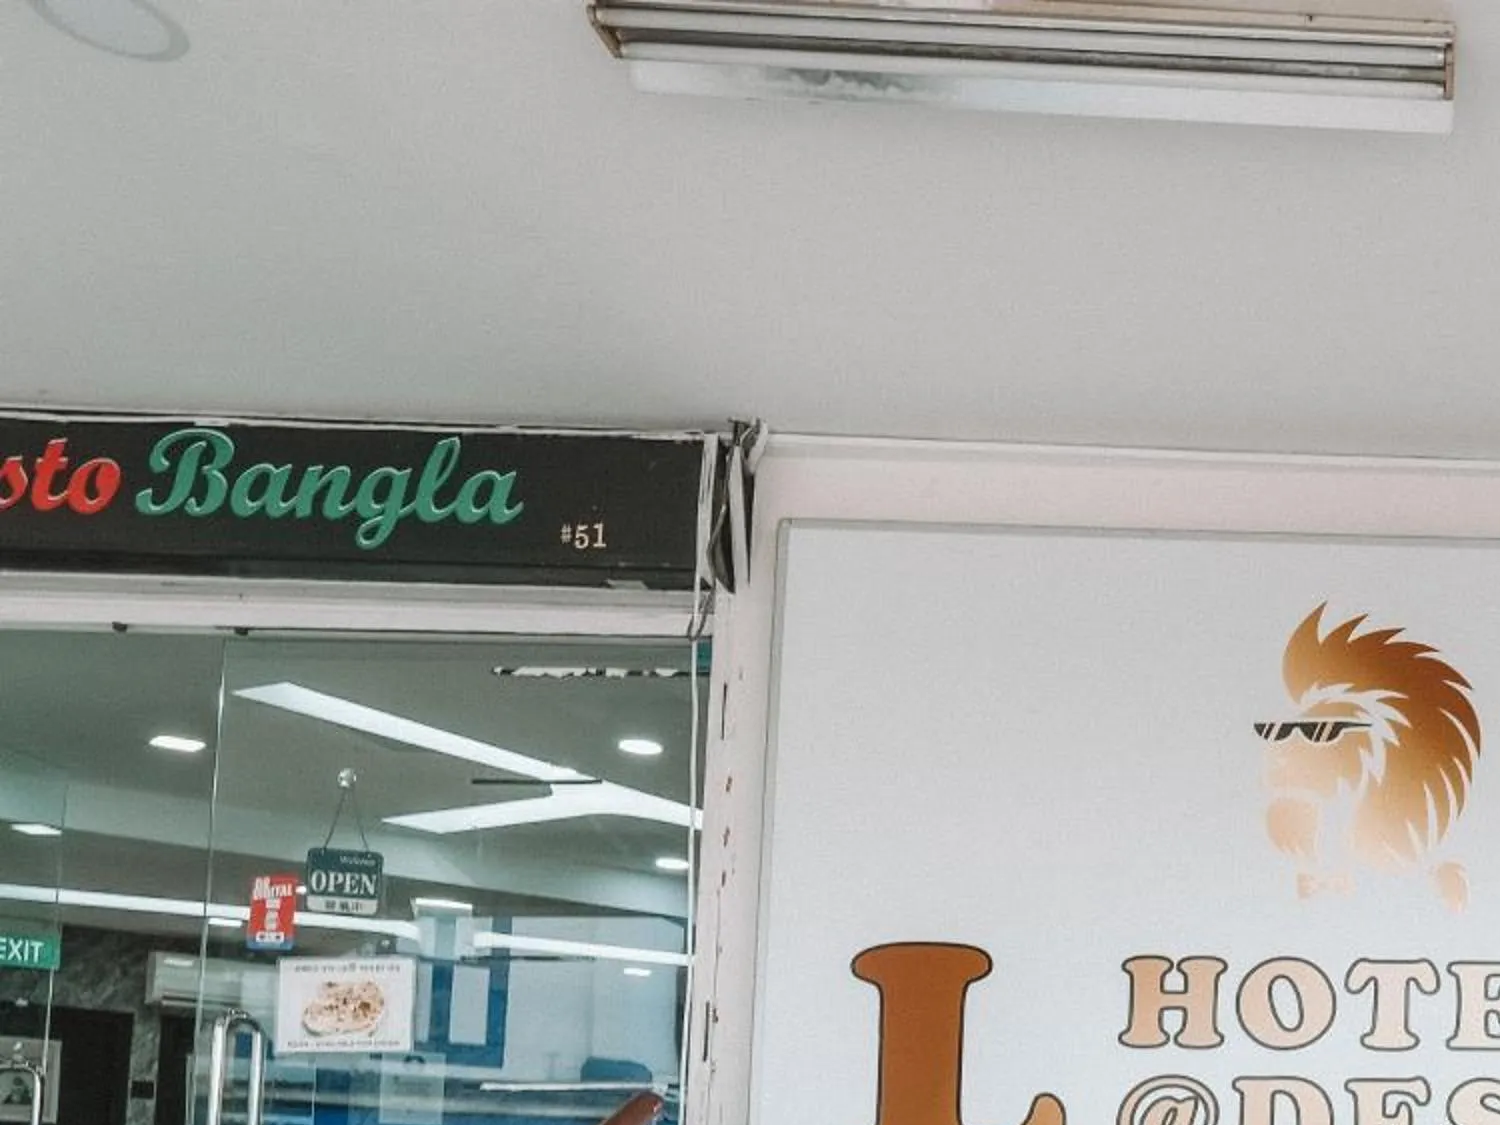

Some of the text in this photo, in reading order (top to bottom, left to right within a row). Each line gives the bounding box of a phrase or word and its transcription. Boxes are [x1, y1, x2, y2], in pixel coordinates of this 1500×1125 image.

[136, 428, 523, 550] Bangla
[560, 522, 607, 549] #51
[310, 869, 377, 896] OPEN
[0, 936, 45, 963] EXIT
